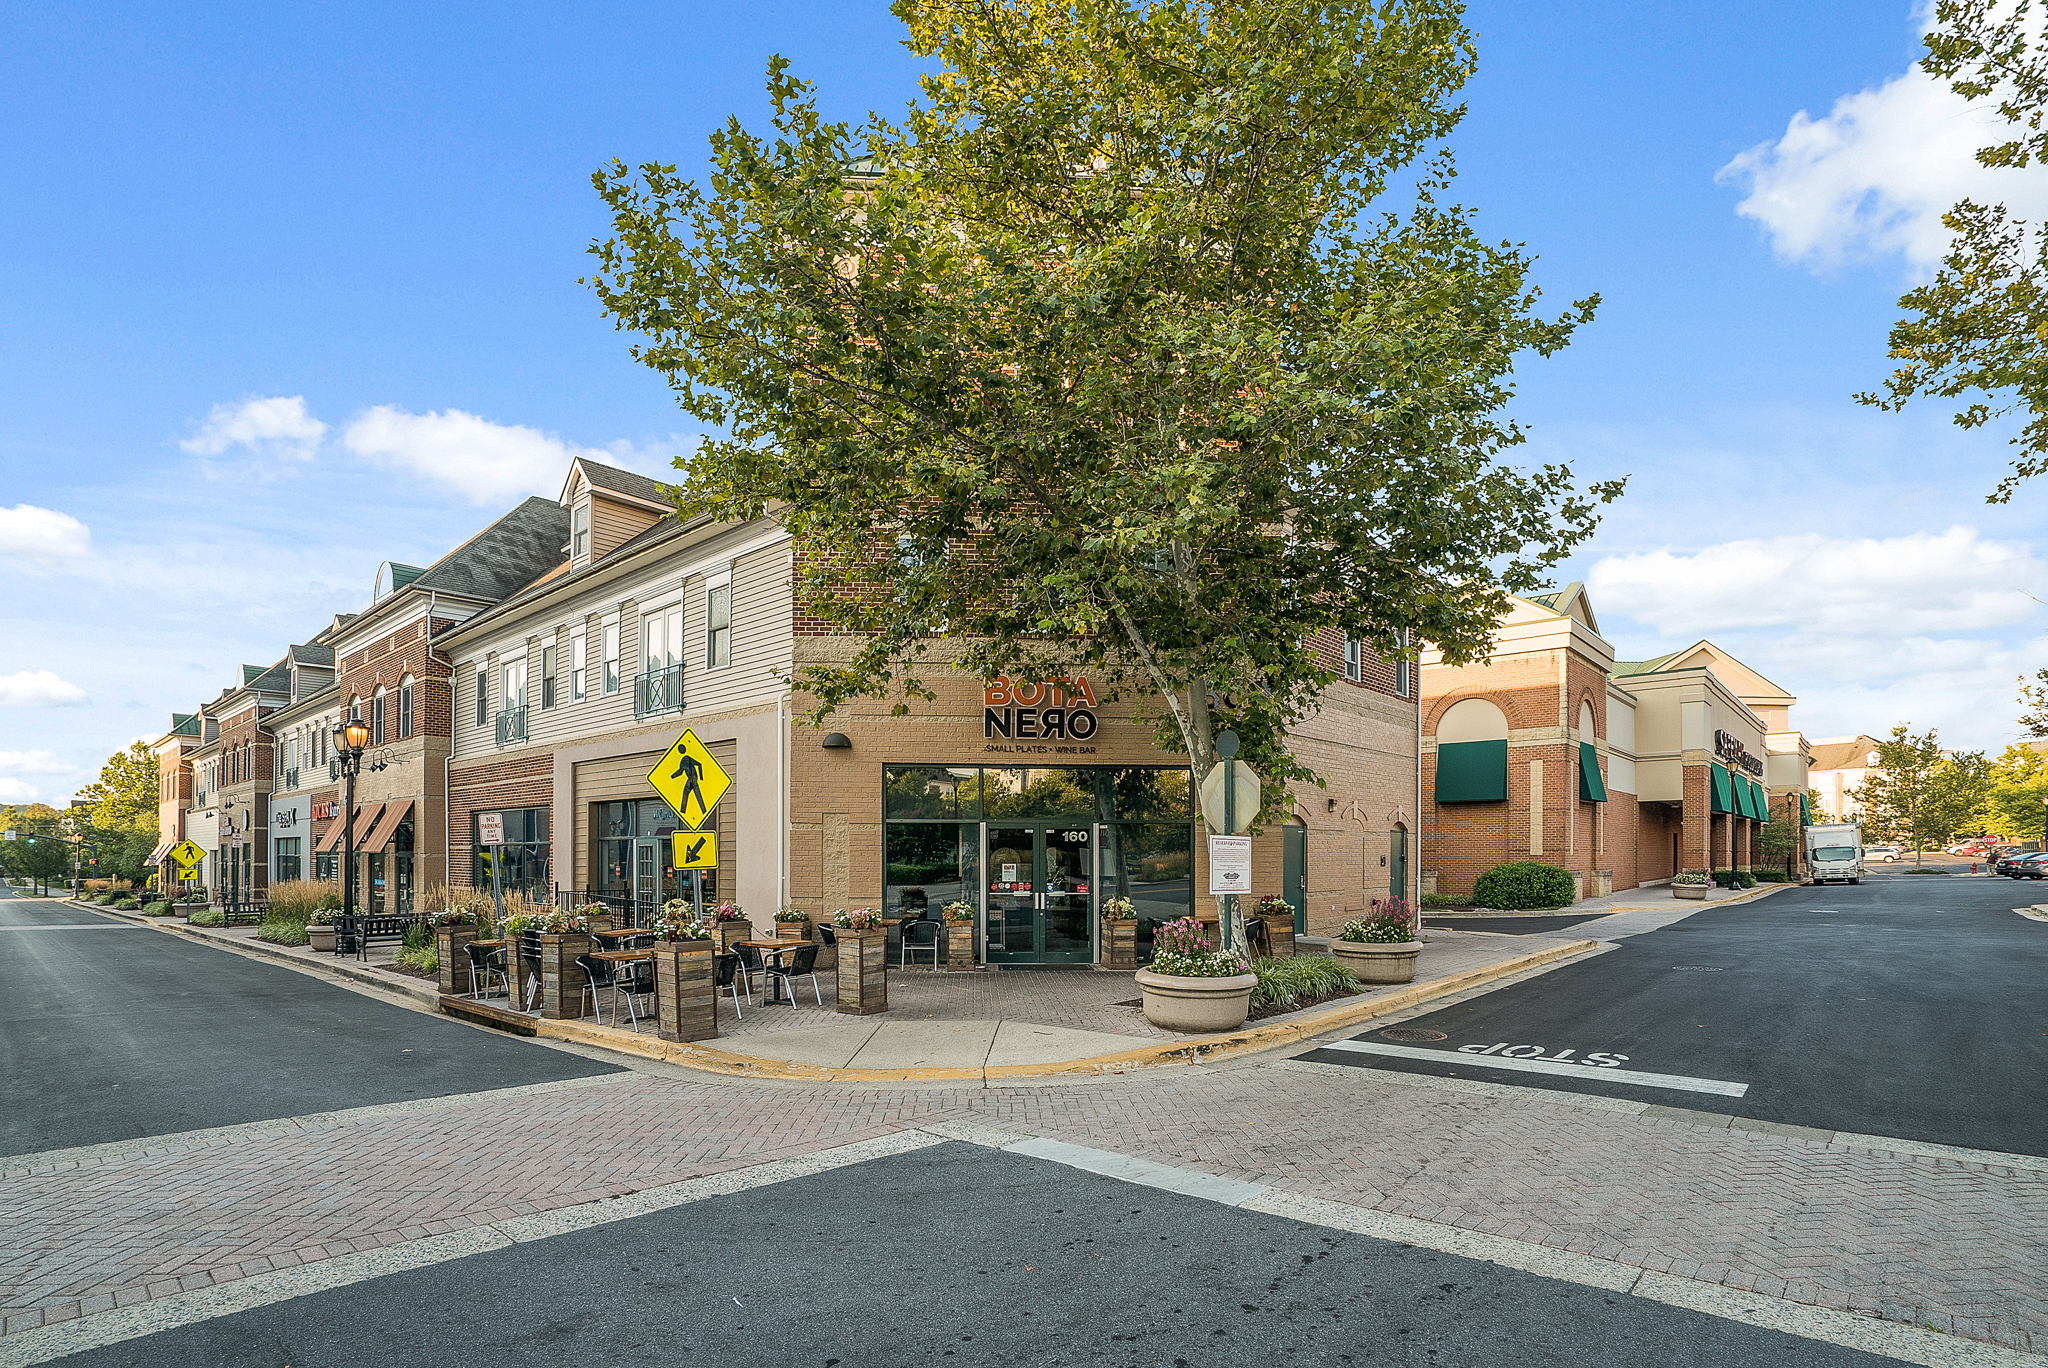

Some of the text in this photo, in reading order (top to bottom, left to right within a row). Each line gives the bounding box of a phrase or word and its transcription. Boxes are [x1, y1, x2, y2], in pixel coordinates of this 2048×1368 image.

[984, 675, 1097, 707] BOTA
[985, 744, 1096, 754] SMALL PLATES WINE BAR
[1062, 831, 1088, 842] 160
[1457, 1042, 1630, 1067] STOP
